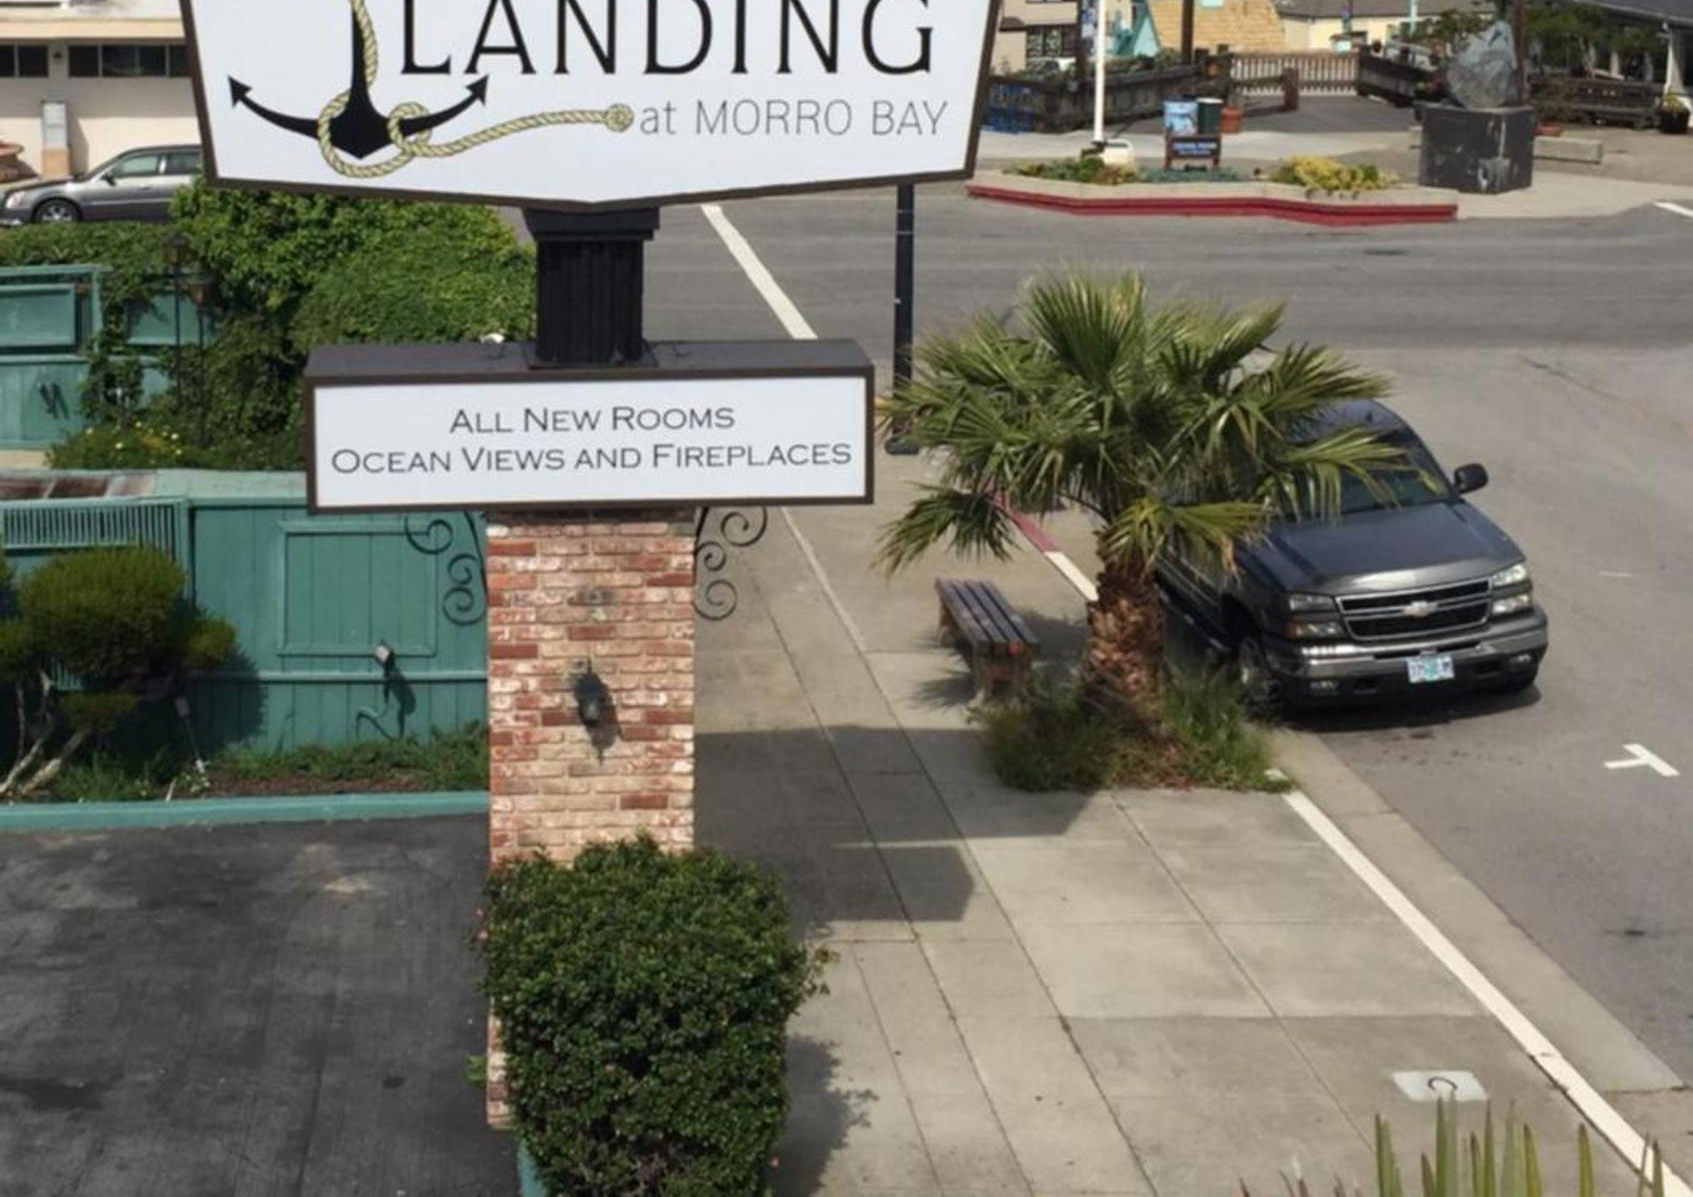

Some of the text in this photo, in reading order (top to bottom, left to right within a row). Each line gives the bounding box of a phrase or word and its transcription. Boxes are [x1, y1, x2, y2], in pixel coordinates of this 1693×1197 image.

[640, 99, 947, 135] at MORRO BAY
[450, 406, 735, 433] ALL NEW ROOMS
[332, 443, 851, 474] OCEAN VIEWS AND FIREPLACES
